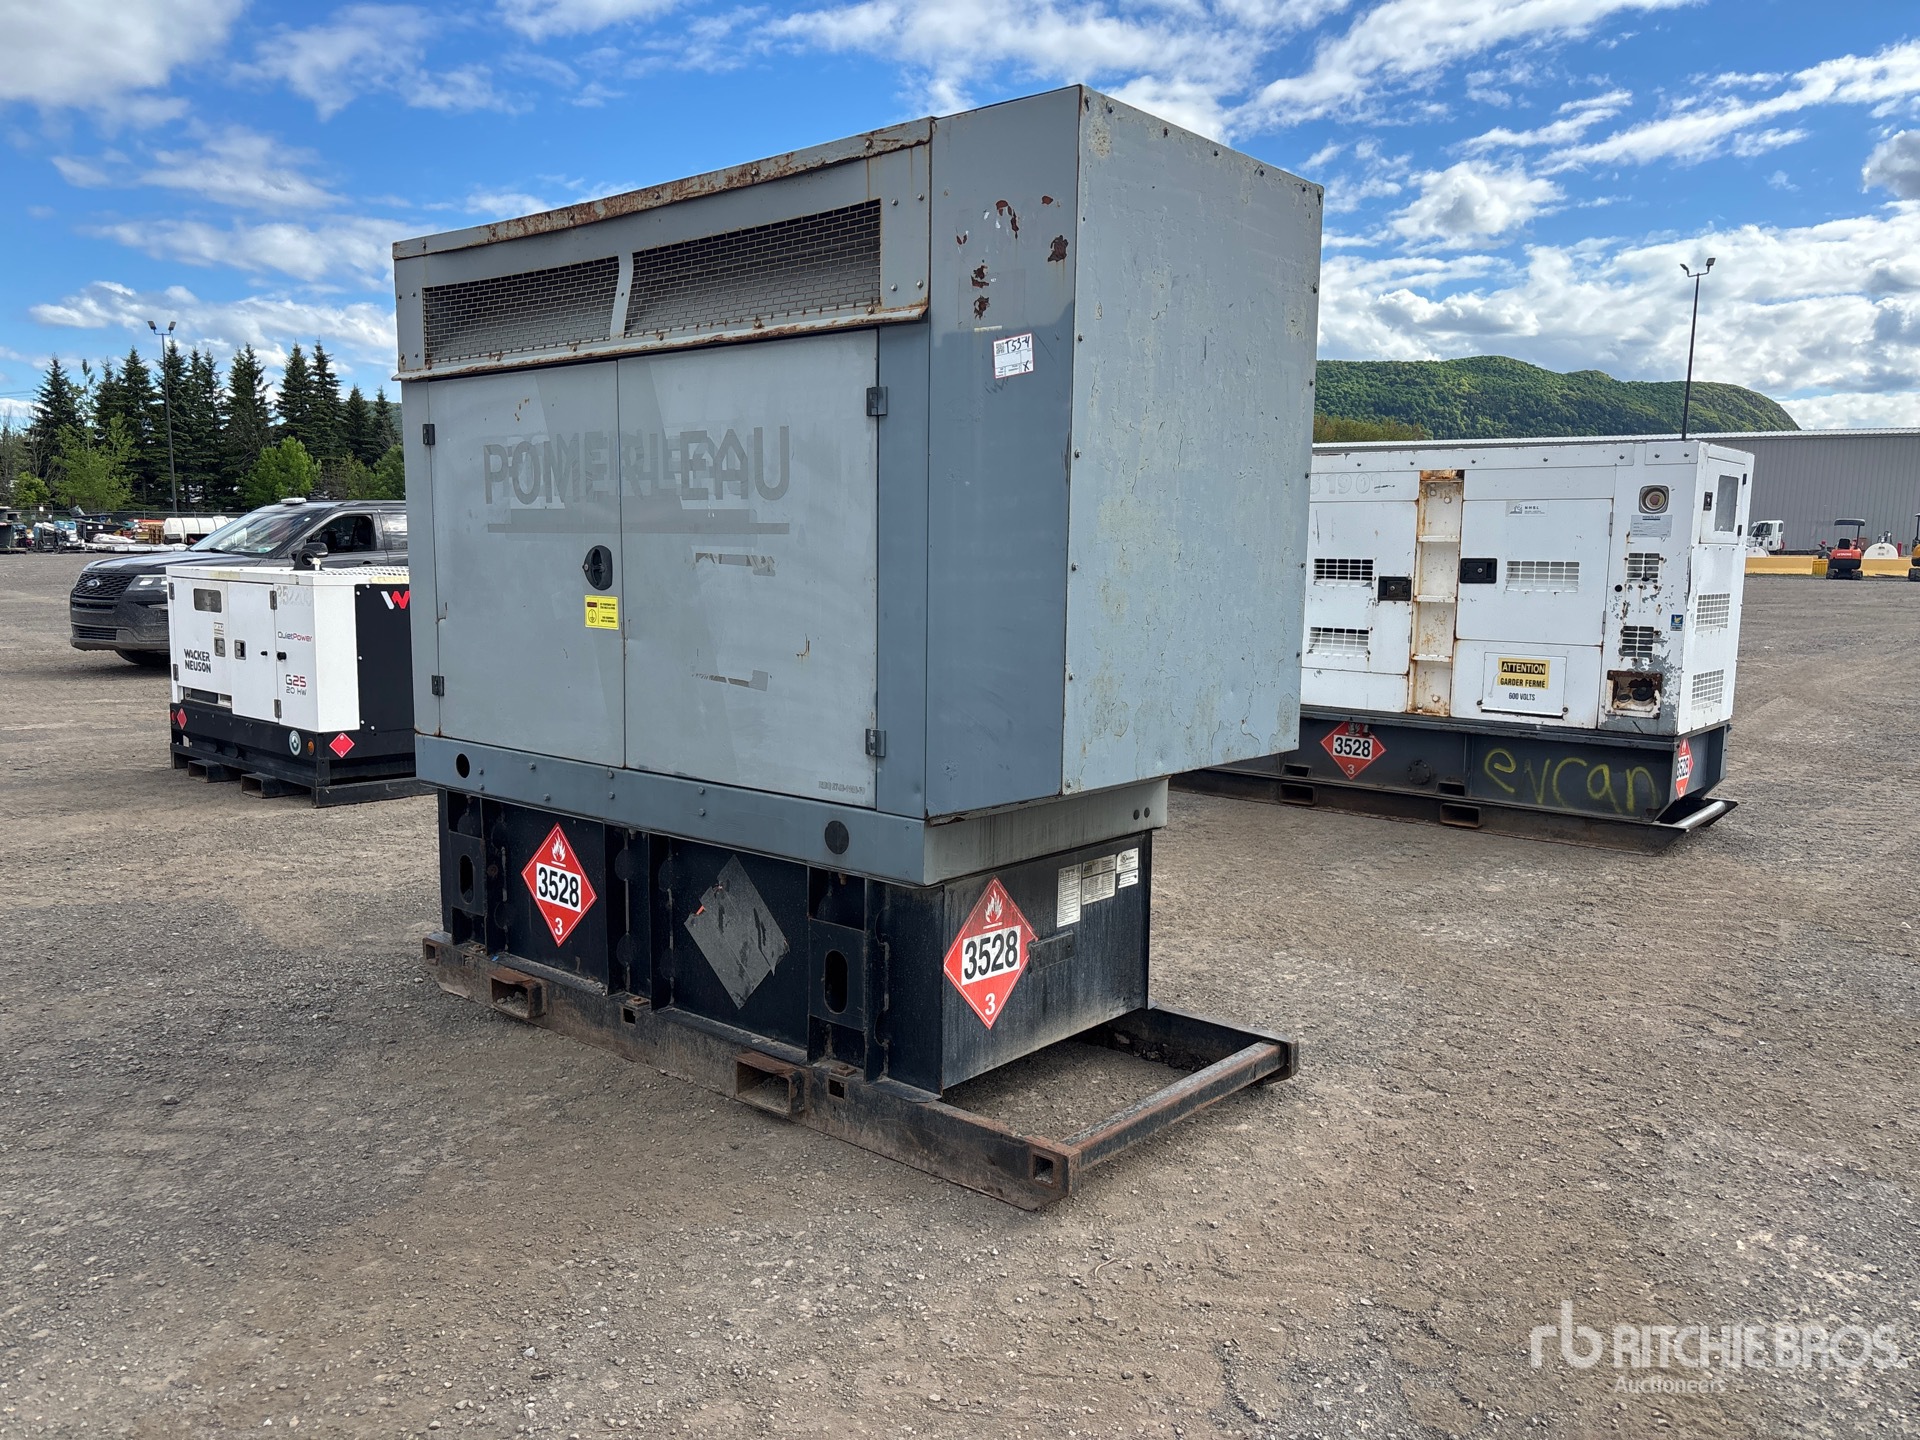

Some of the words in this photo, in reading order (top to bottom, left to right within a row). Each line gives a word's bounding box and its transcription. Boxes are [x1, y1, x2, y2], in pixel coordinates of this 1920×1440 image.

[183, 648, 211, 663] WACKER
[184, 660, 212, 674] NEUSON
[1502, 662, 1546, 674] ATTENTION
[285, 674, 307, 688] G25
[1500, 677, 1524, 687] GARDER
[1525, 678, 1546, 688] FERMÉ
[1508, 692, 1519, 700] 600
[1519, 693, 1536, 701] VOLTS
[1334, 736, 1371, 758] 3528
[1347, 763, 1356, 775] 3
[538, 866, 580, 908] 3528
[554, 917, 563, 936] 3
[963, 930, 1018, 980] 3528
[984, 992, 996, 1016] 3
